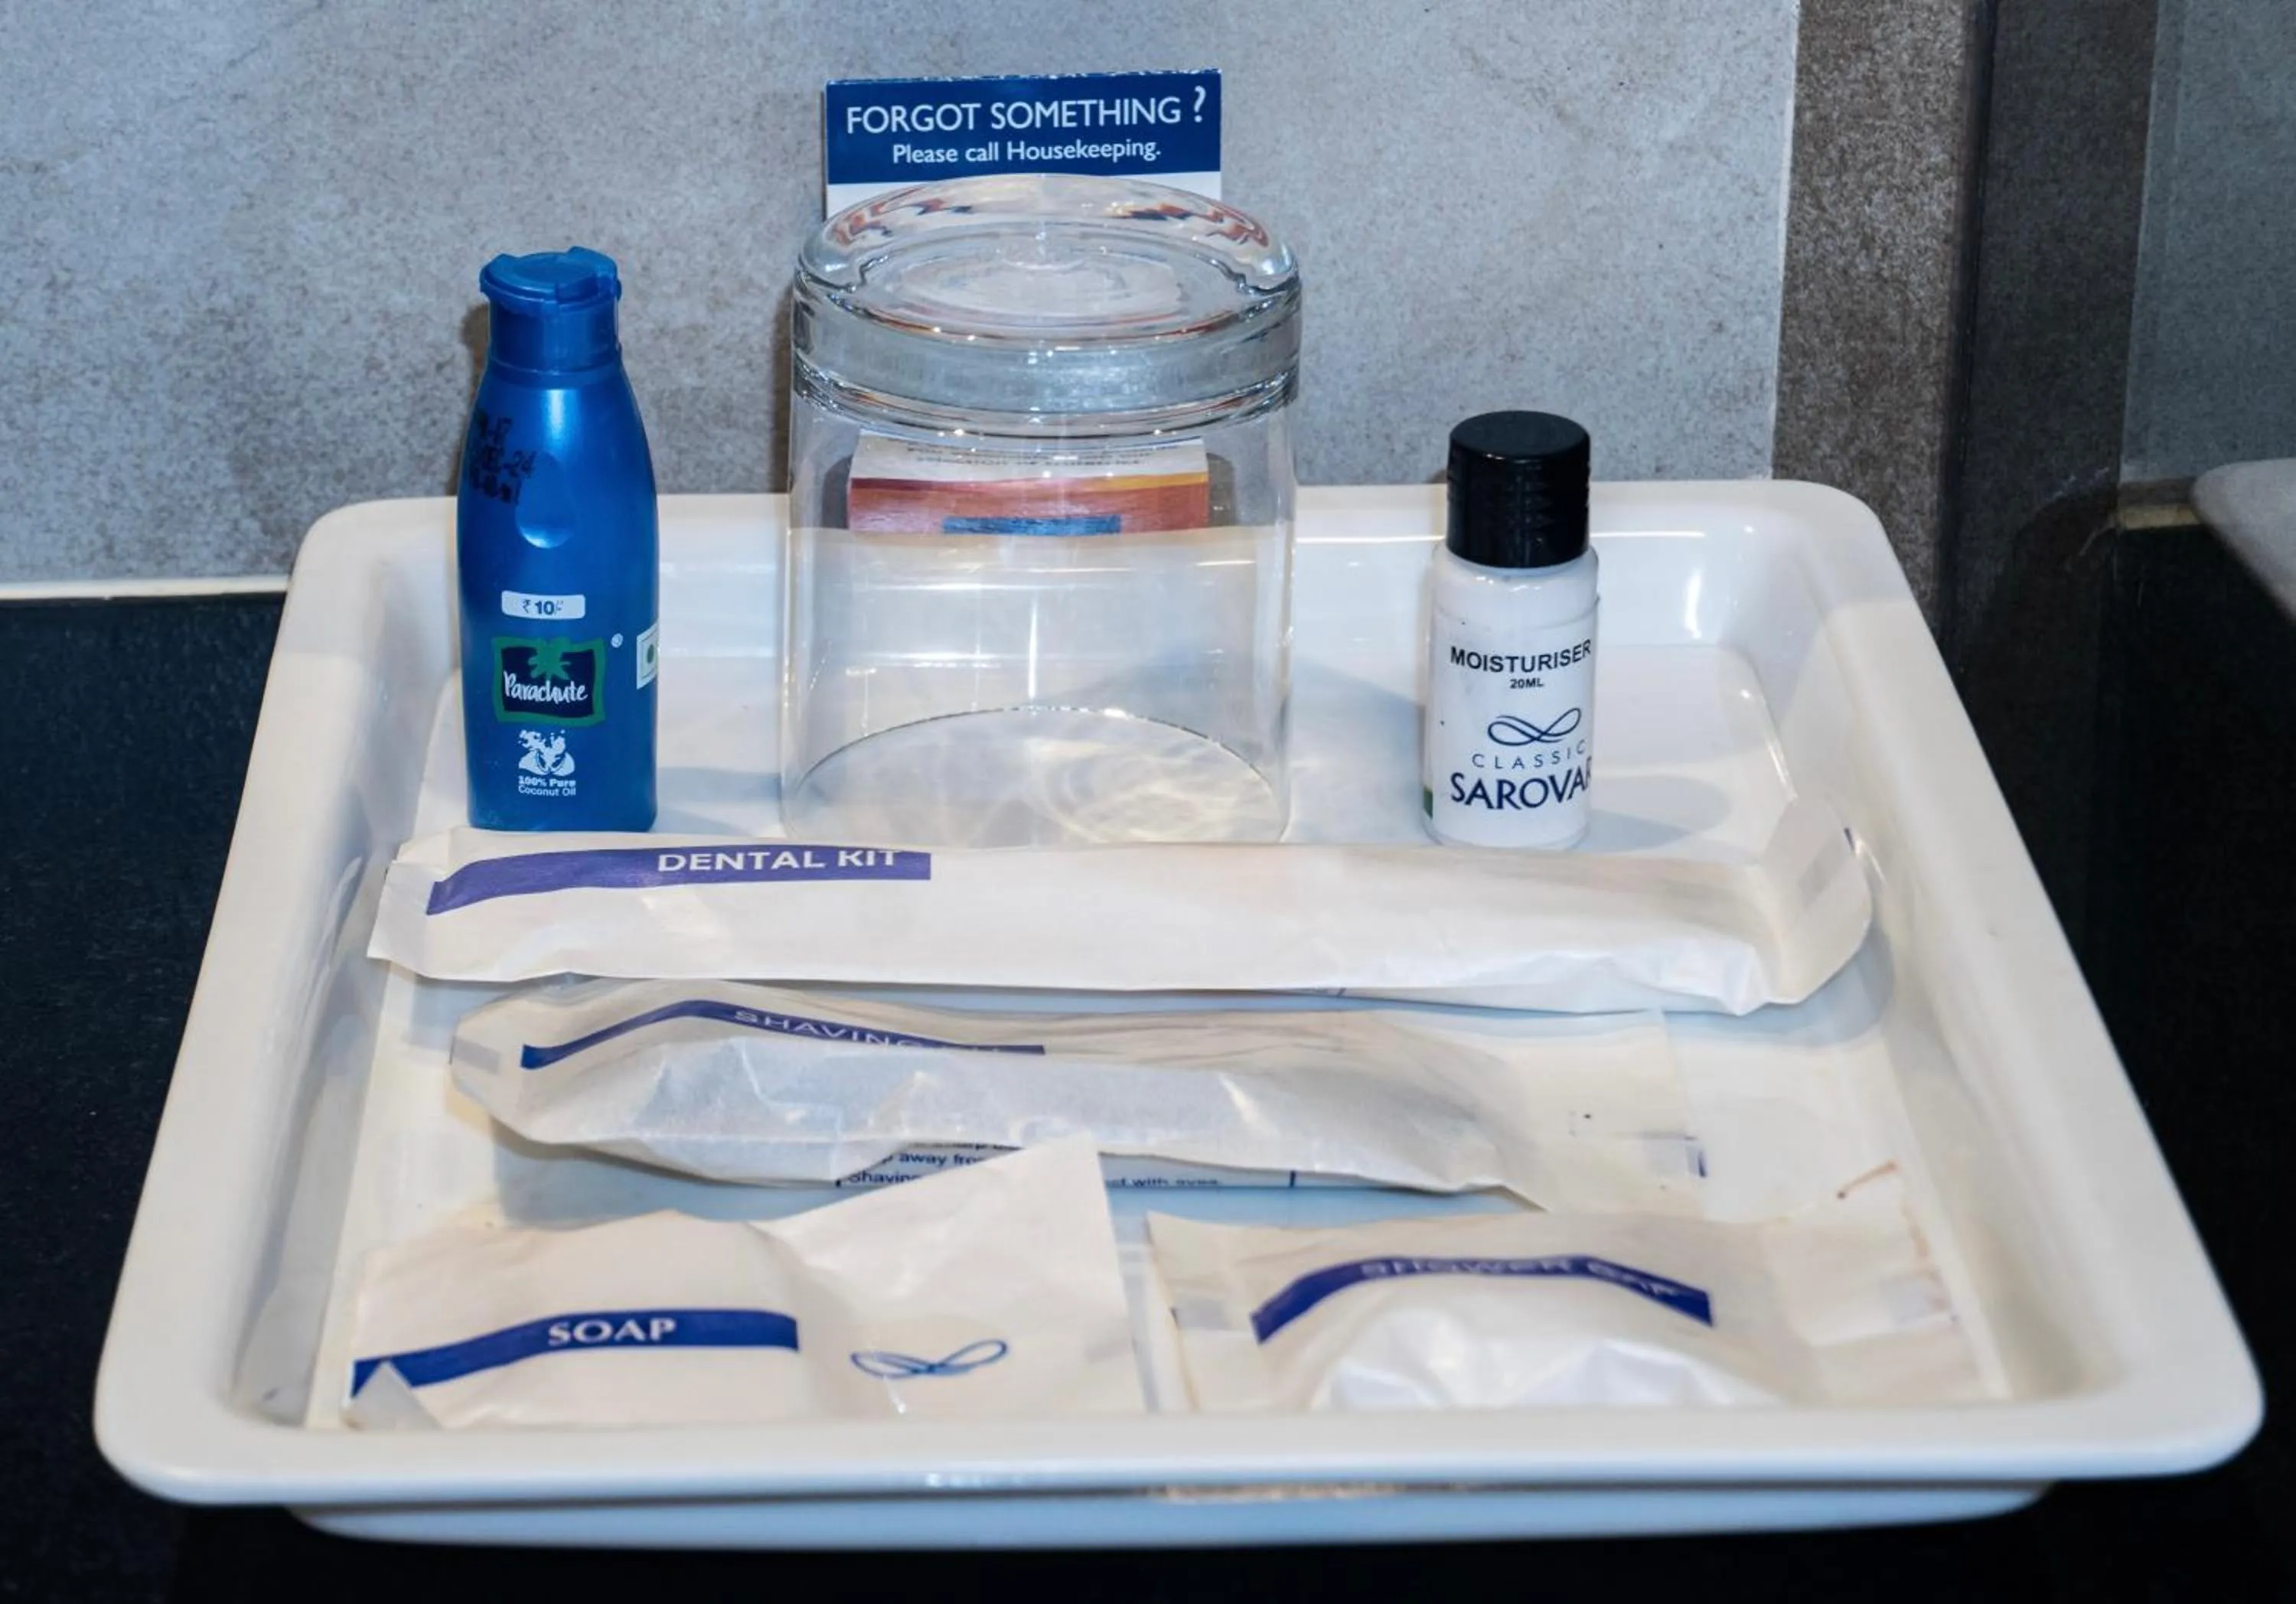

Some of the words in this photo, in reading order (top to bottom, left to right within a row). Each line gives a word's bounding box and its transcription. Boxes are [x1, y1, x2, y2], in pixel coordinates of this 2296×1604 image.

[846, 103, 981, 134] FORGOT
[991, 96, 1181, 130] SOMETHING
[1193, 86, 1207, 122] ?
[892, 144, 958, 164] Please
[965, 142, 999, 161] call
[1007, 139, 1161, 161] Housekeeping.
[1450, 639, 1592, 673] MOISTURISER
[504, 671, 588, 705] Parachute
[1510, 678, 1544, 690] 20ML
[1472, 740, 1586, 769] CLASSIC
[518, 785, 559, 797] Coconut
[563, 787, 576, 797] Oil
[519, 775, 546, 787] 100%
[550, 778, 576, 787] Pure
[657, 851, 826, 872] DENTAL
[838, 850, 898, 867] KIT
[899, 1152, 947, 1168] away
[547, 1317, 677, 1345] SOAP
